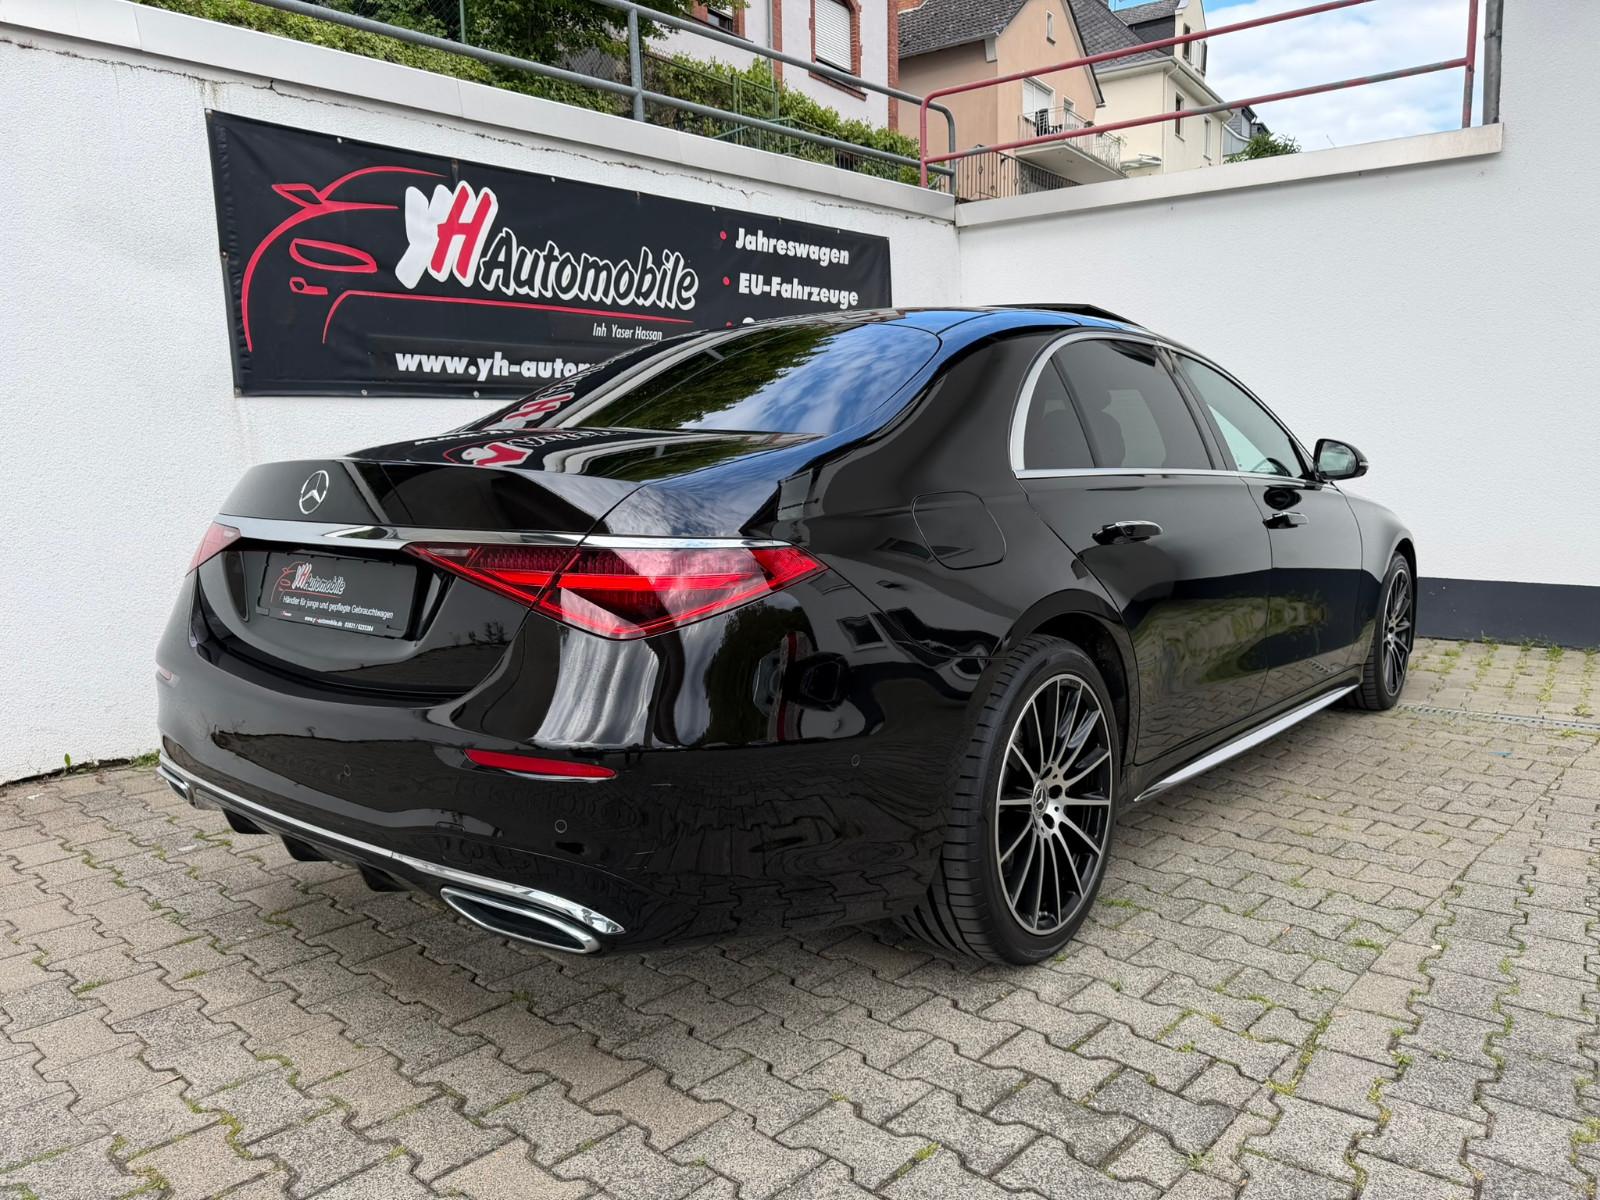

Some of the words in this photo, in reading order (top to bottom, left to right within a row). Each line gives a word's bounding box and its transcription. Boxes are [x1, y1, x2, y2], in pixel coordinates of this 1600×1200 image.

[735, 227, 850, 267] Jahreswagen
[479, 227, 699, 310] Automobile
[738, 272, 859, 310] EU-Fahrzeuge
[592, 322, 607, 337] Inh
[611, 324, 634, 339] Yaser
[634, 325, 663, 341] Hassan
[305, 599, 319, 610] junge
[319, 601, 330, 610] und
[328, 602, 351, 613] gepflegte
[351, 604, 394, 620] Gebrauchtwagen
